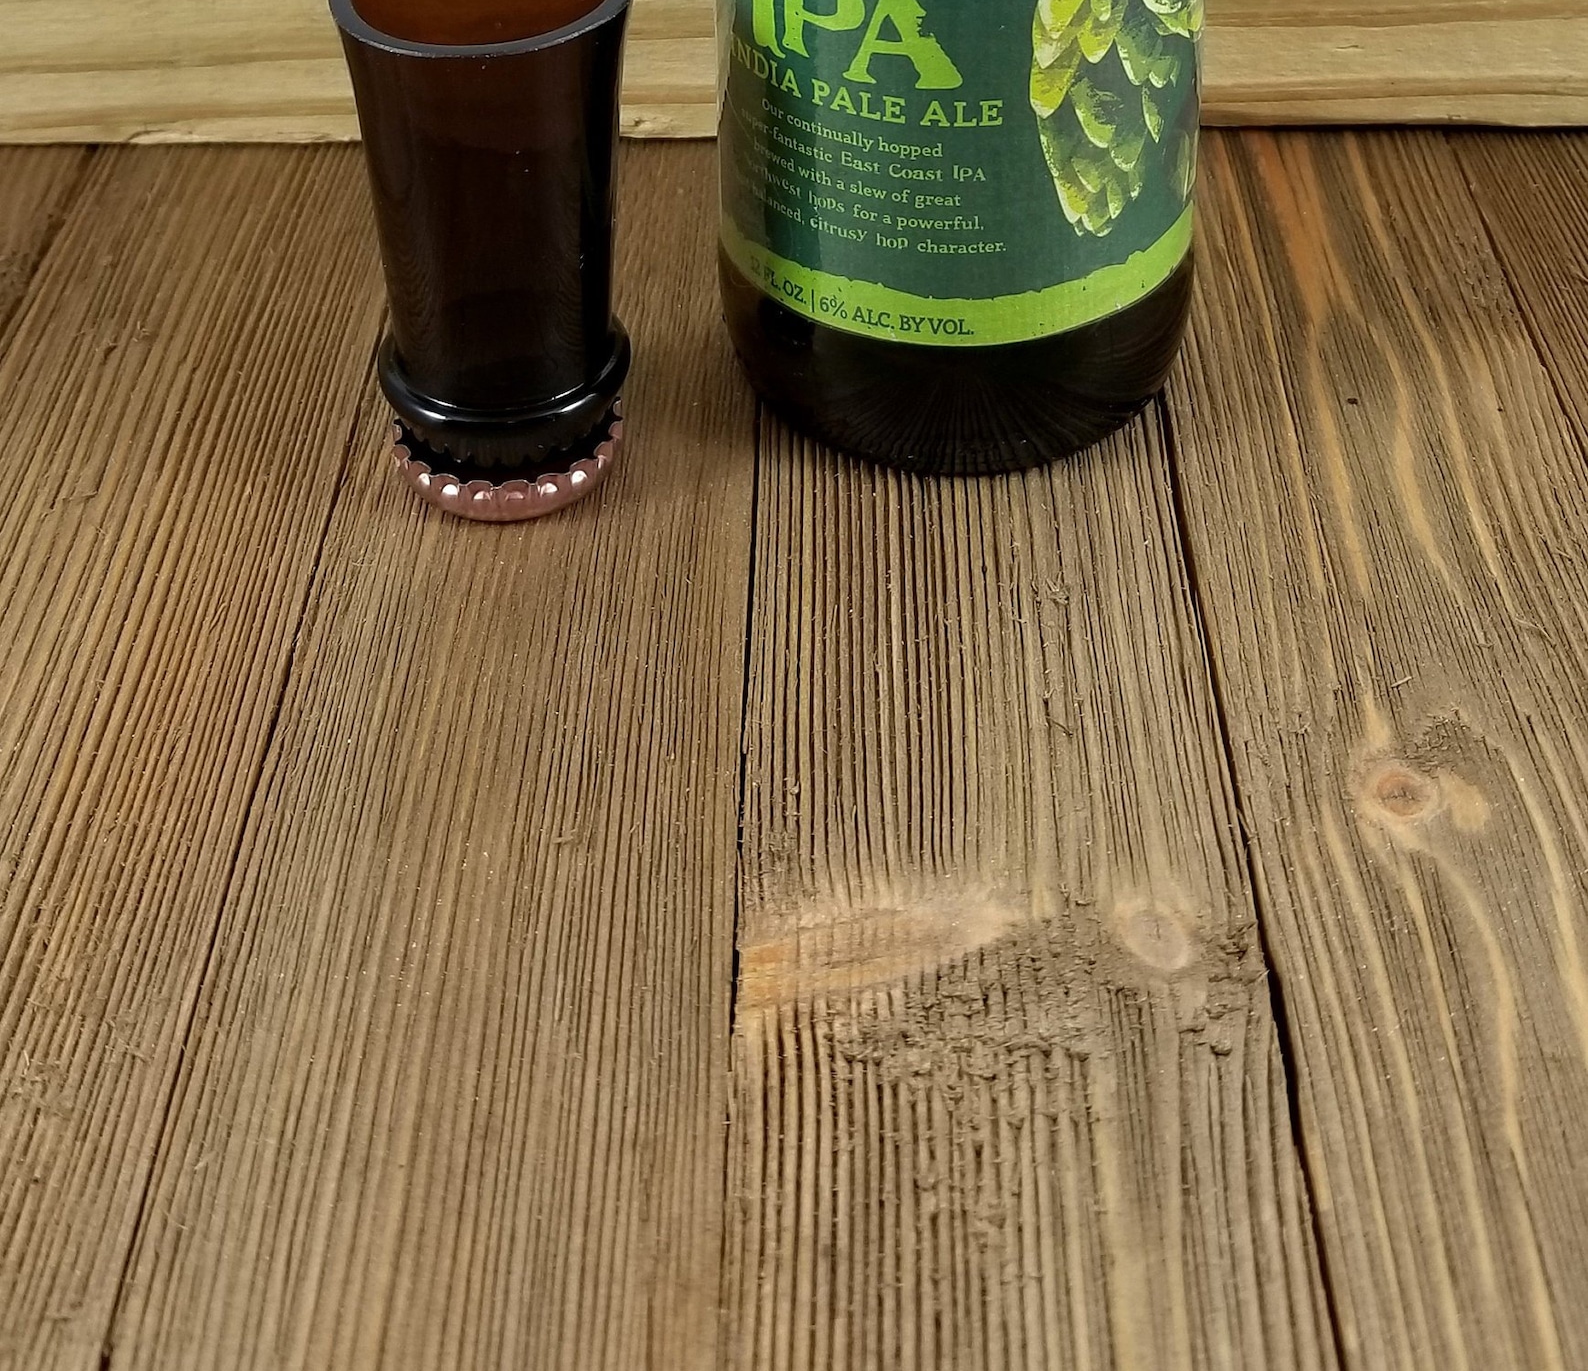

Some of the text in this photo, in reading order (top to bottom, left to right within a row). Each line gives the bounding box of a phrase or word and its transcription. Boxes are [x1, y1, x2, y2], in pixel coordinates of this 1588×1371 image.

[811, 78, 906, 124] PALE
[919, 100, 1004, 127] ALE
[761, 98, 943, 160] Our continually hopped
[754, 137, 961, 209] brewed with a slew of great
[841, 150, 881, 174] East
[888, 163, 943, 182] Coast
[952, 164, 987, 182] IPA
[808, 189, 845, 213] hops
[853, 203, 878, 222] for
[882, 213, 892, 225] a
[809, 216, 867, 242] citrusy
[875, 232, 909, 250] hop
[917, 238, 1007, 254] character.
[819, 295, 848, 320] 6%
[851, 305, 895, 330] ALC.
